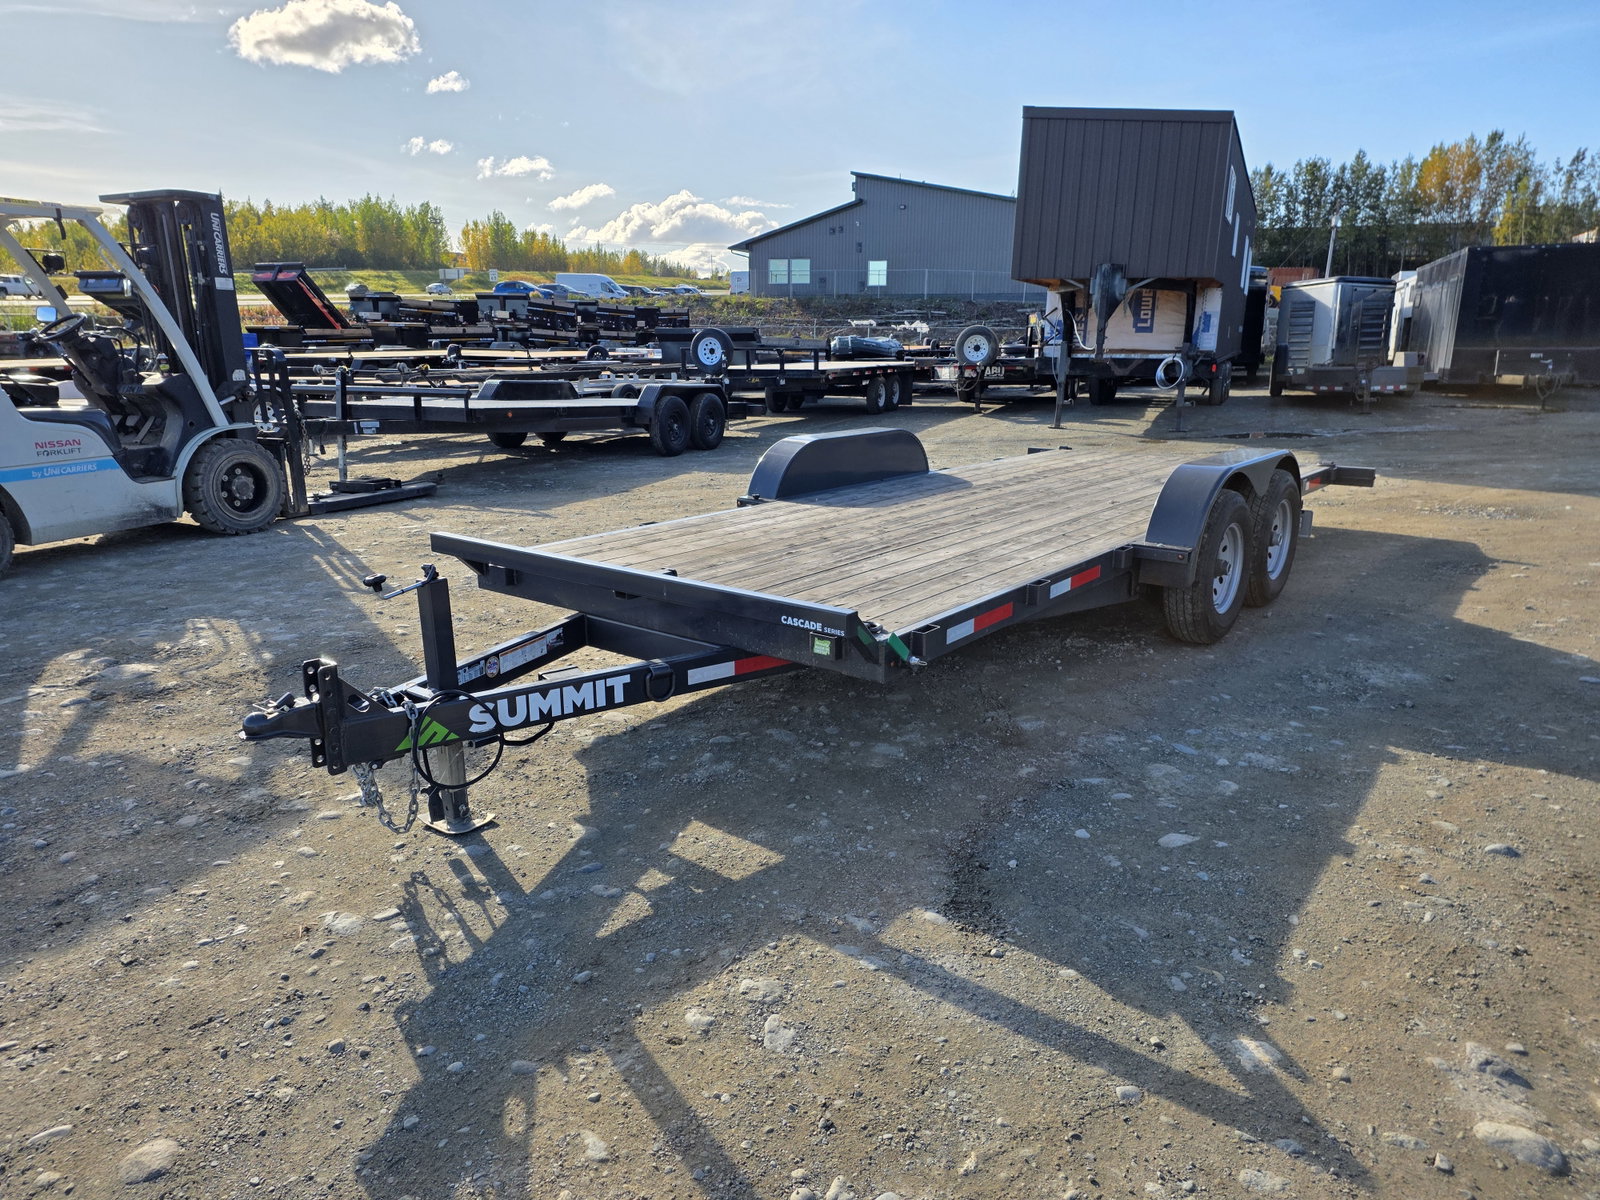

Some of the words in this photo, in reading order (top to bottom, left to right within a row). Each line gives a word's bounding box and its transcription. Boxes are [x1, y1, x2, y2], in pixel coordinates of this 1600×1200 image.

[34, 439, 81, 449] NISSAN
[36, 447, 82, 457] FORKLIFT
[31, 470, 42, 478] by
[781, 615, 823, 632] CASCADE
[823, 626, 845, 636] SERIES
[468, 674, 631, 733] SUMMIT
